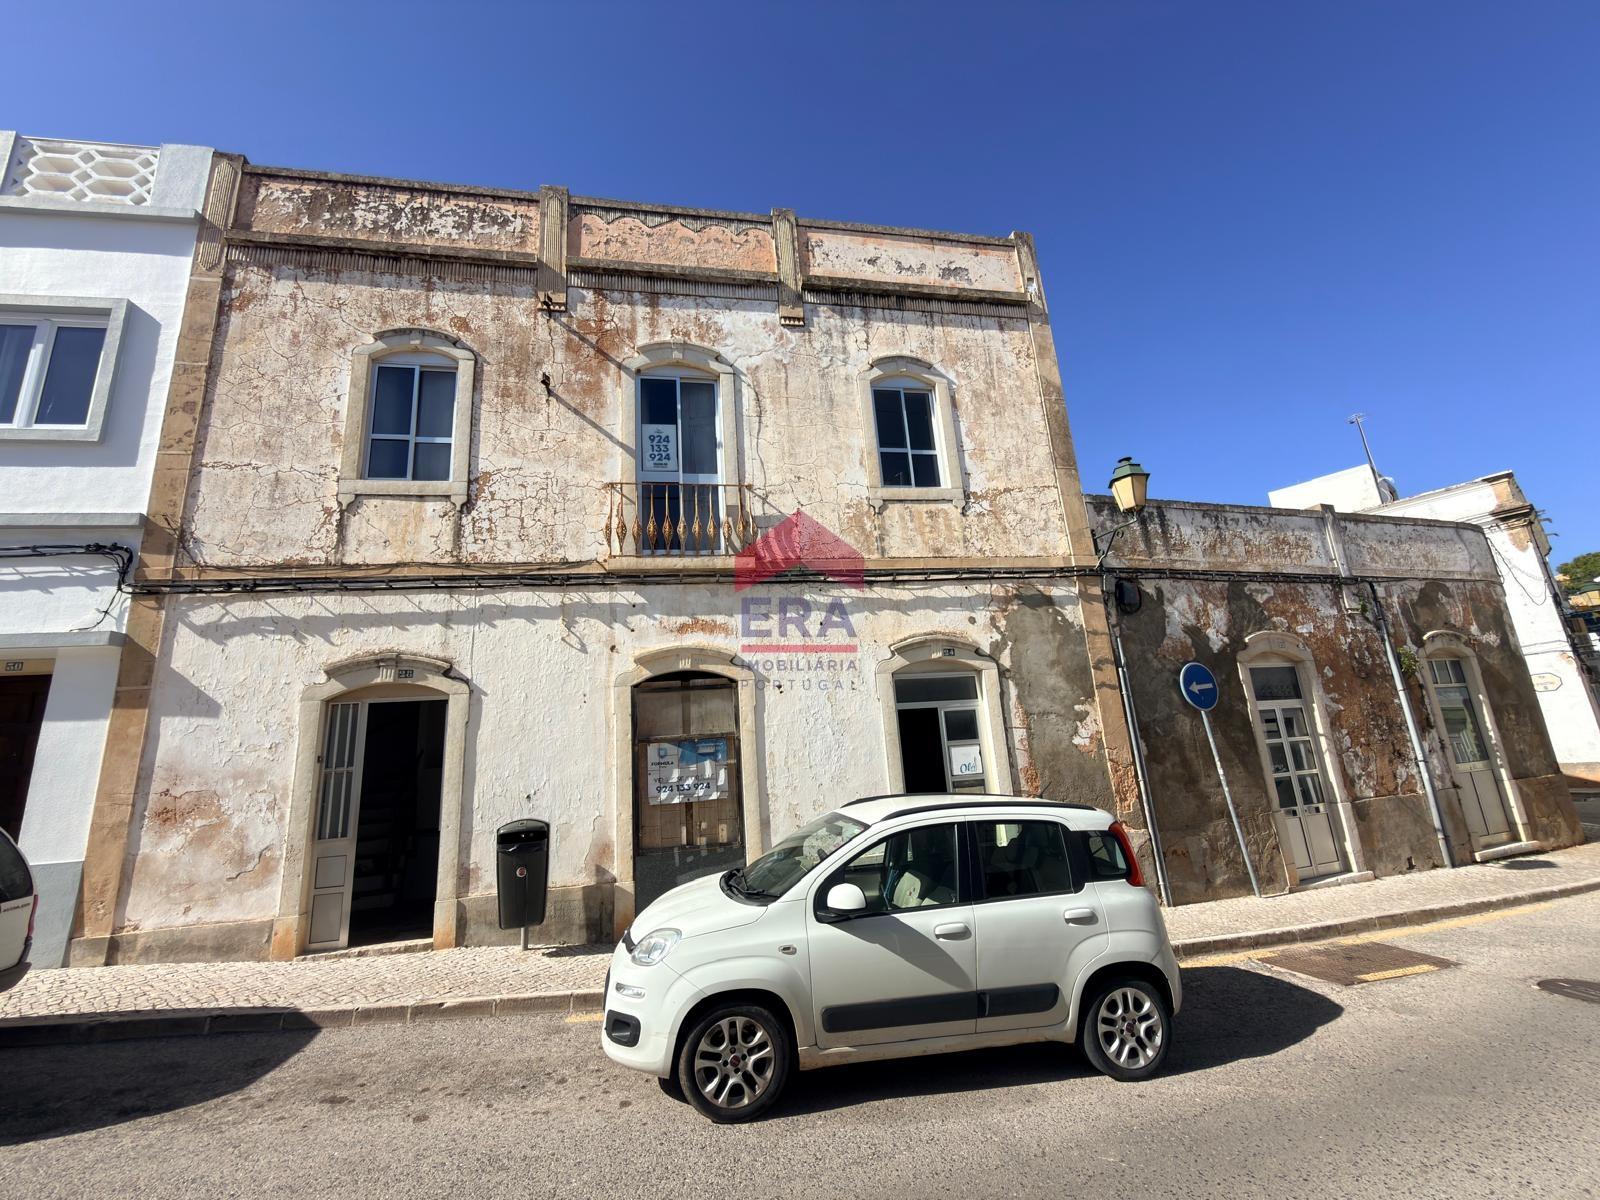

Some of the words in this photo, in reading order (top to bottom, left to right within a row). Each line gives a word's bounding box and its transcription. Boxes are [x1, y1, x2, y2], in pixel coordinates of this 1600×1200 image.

[648, 434, 670, 443] 924
[650, 444, 670, 452] 133
[649, 453, 671, 461] 924
[656, 785, 673, 793] 924
[676, 784, 691, 792] 133
[694, 782, 711, 790] 924
